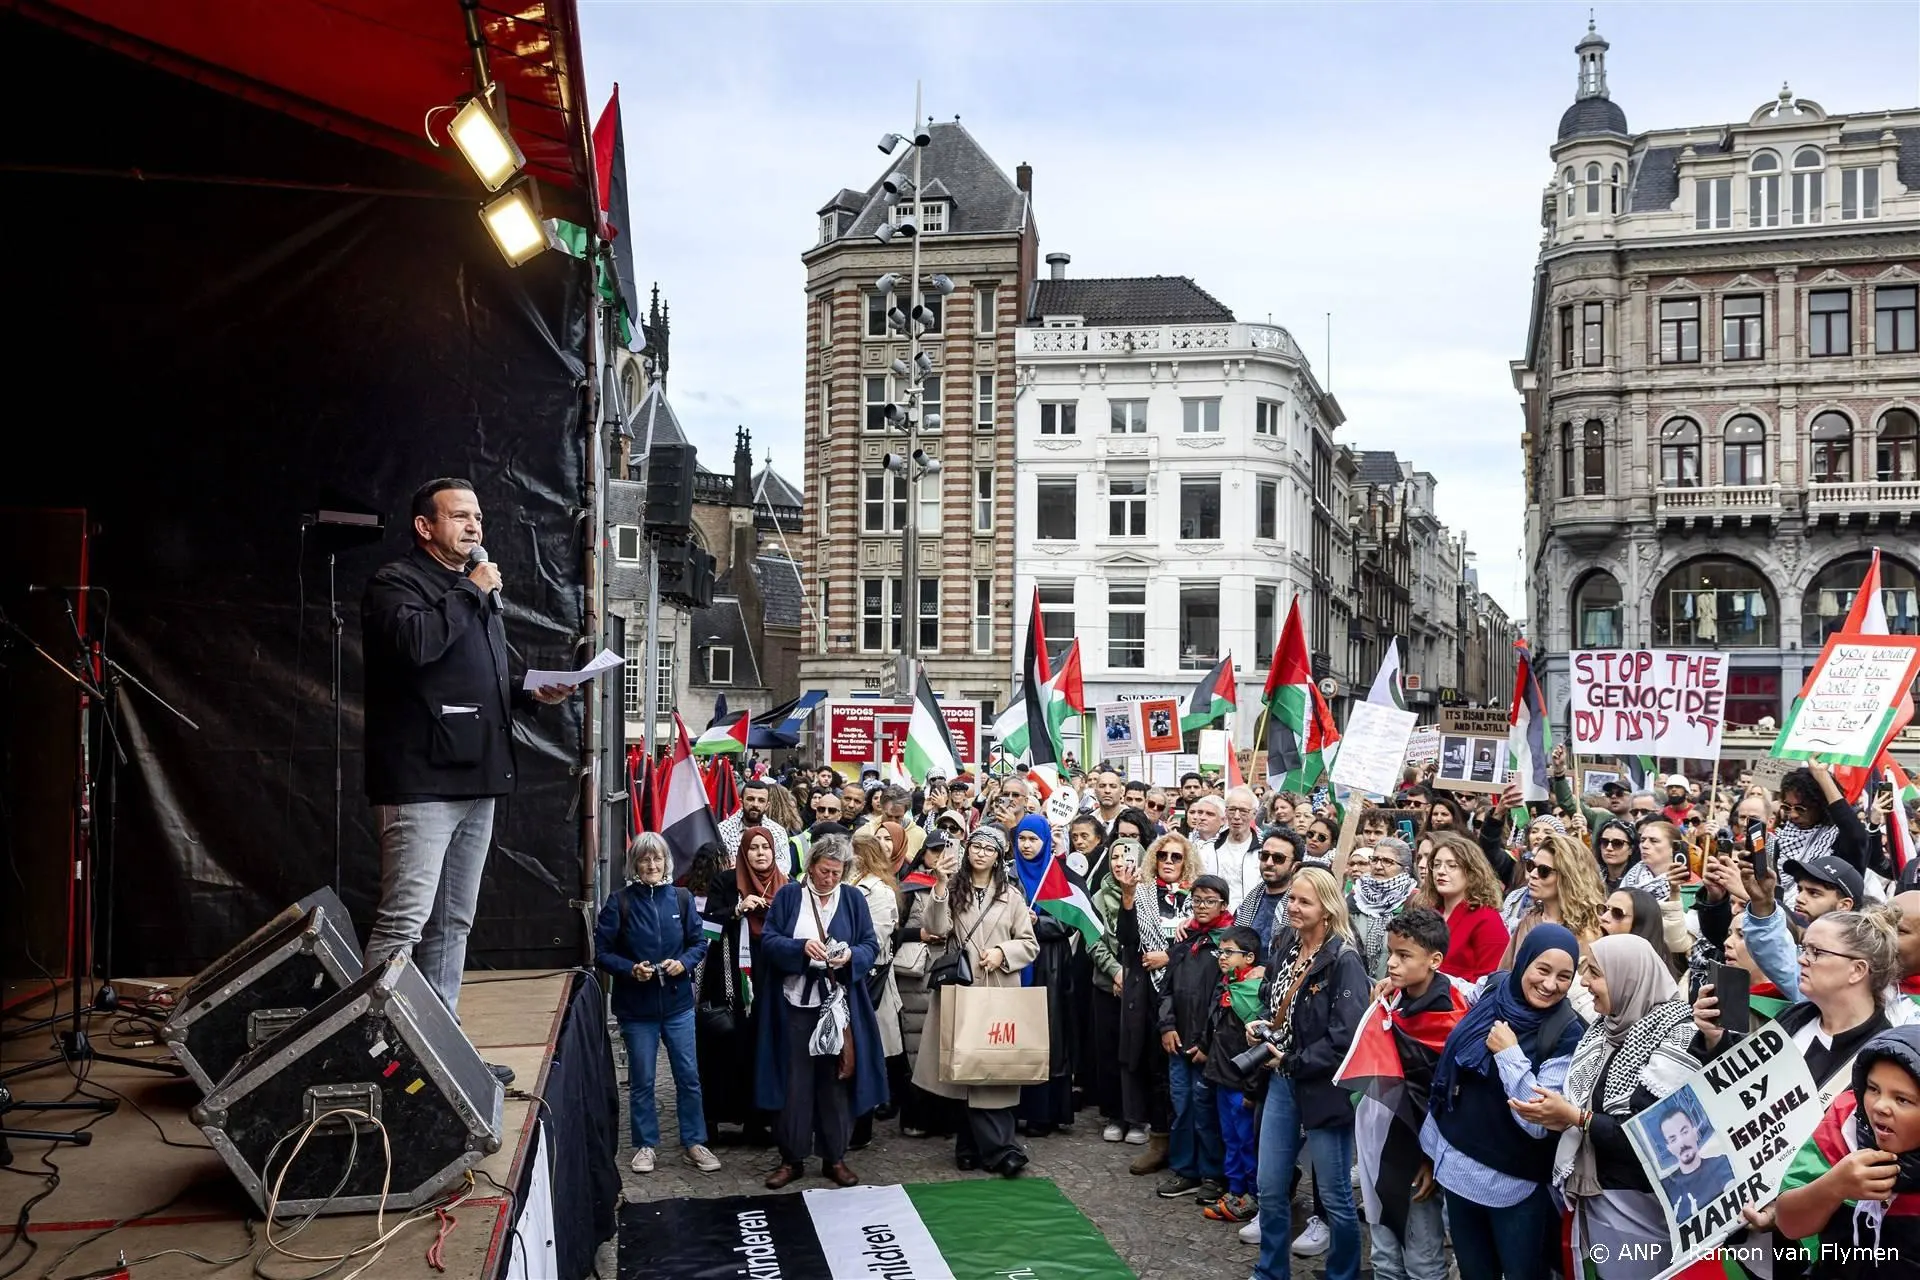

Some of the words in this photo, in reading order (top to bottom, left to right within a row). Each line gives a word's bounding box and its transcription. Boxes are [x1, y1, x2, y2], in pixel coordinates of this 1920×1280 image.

[1575, 652, 1653, 685] STOP
[1665, 653, 1722, 689] THE
[1587, 683, 1725, 715] GENOCIDE
[1863, 682, 1881, 695] to
[833, 707, 874, 716] HOTDOGS
[940, 709, 974, 717] OTDOGS
[1454, 722, 1470, 731] AND
[1482, 723, 1505, 732] STILL
[987, 1022, 1015, 1045] H&M
[1738, 1074, 1769, 1110] BY
[1762, 1121, 1786, 1146] AND
[1748, 1135, 1790, 1172] USA
[1678, 1172, 1773, 1253] MAHER
